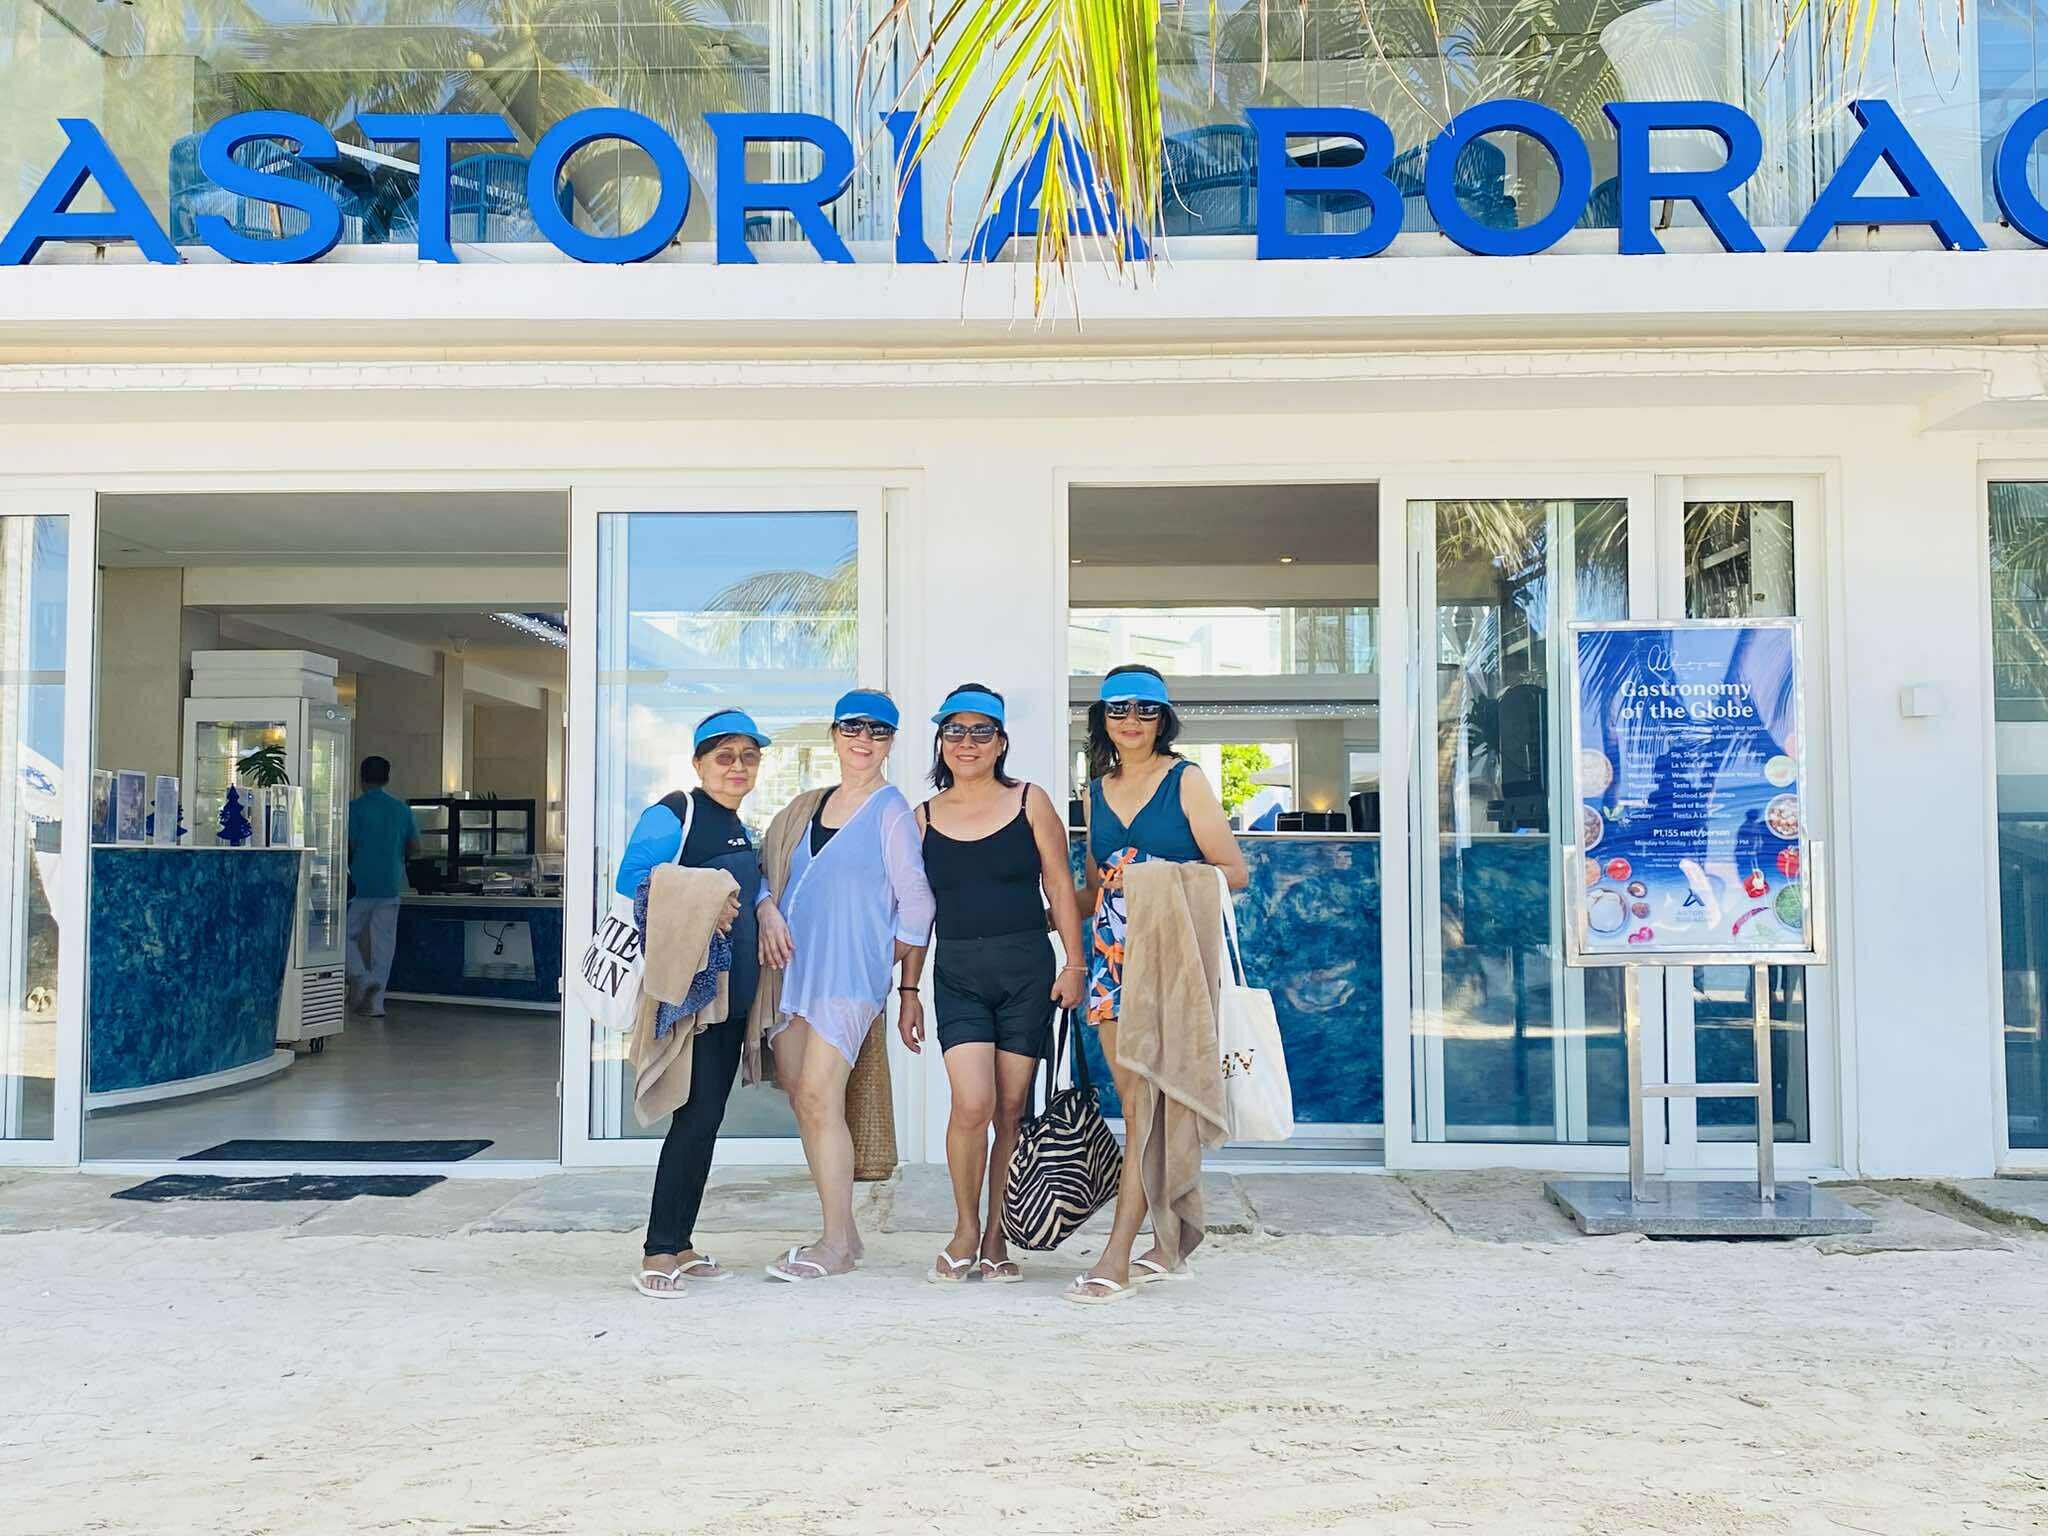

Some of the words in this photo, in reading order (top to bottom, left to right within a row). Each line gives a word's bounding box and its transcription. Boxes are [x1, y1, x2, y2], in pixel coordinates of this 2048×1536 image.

[0, 107, 1152, 266] ASTORIA
[1621, 680, 1751, 700] Gastronomy
[1621, 700, 1643, 719] of
[1650, 701, 1686, 719] the
[1690, 701, 1753, 719] Globe
